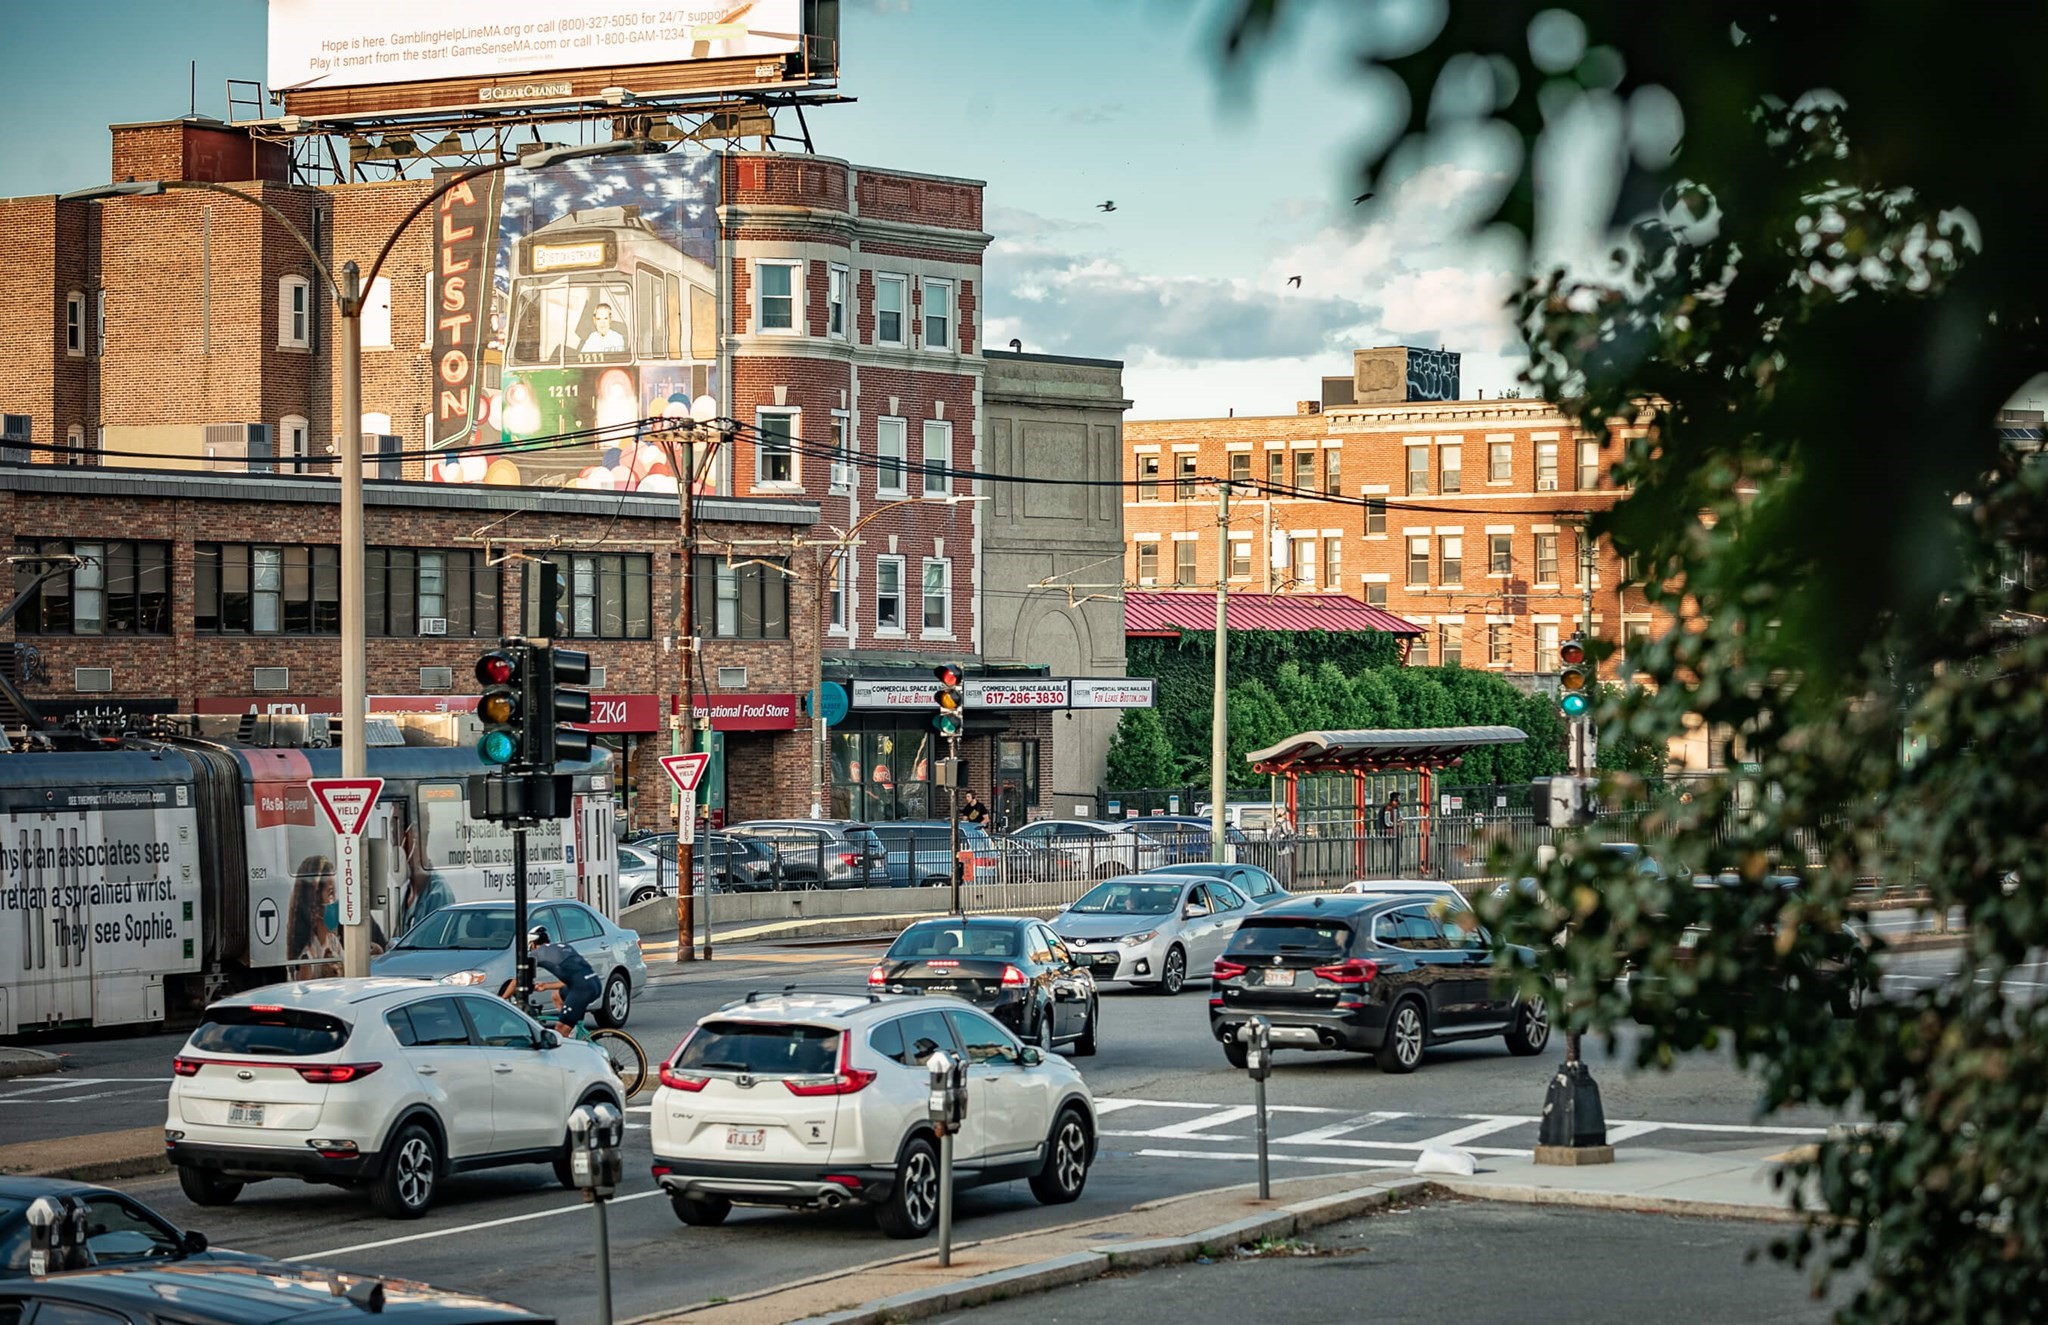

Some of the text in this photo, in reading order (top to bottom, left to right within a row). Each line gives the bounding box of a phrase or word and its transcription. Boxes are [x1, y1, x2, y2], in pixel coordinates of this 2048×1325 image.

[322, 40, 349, 53] Hope
[352, 38, 360, 49] is
[363, 36, 387, 48] here.
[391, 24, 520, 44] GamblingHelpLineMA.org
[523, 24, 534, 34] or
[537, 21, 555, 33] call
[558, 14, 639, 34] (800)-327-5050
[642, 12, 655, 24] for
[660, 11, 685, 24] 24/7
[310, 58, 331, 70] Play
[333, 56, 341, 67] it
[343, 53, 373, 66] smart
[375, 51, 400, 63] from
[403, 49, 419, 61] the
[422, 46, 448, 59] start!
[451, 39, 556, 57] GameSenseMA.com
[560, 36, 571, 48] or
[573, 34, 592, 47] call
[596, 28, 687, 45] 1-800-GAM-1234.
[439, 174, 476, 420] ALLSTON
[578, 353, 605, 363] 1211
[549, 384, 578, 397] 1211
[986, 692, 1064, 704] 617-286-3830
[692, 704, 789, 718] ternational Food Store
[284, 797, 308, 814] Beyond
[337, 806, 359, 815] YIELD
[455, 820, 497, 843] Physician
[546, 822, 561, 836] see
[59, 837, 141, 868] associates
[145, 841, 170, 864] see
[448, 851, 471, 865] more
[473, 845, 493, 864] than
[495, 848, 501, 862] a
[251, 867, 267, 879] 3621
[345, 837, 353, 921] TO TROLLEY
[483, 869, 504, 892] They
[528, 867, 554, 890] ophie.
[15, 881, 47, 910] than
[52, 889, 60, 907] a
[65, 875, 131, 913] sprained
[136, 873, 176, 901] wrist.
[52, 912, 177, 951] They see Sophie.
[259, 909, 275, 937] T
[672, 1112, 694, 1120] CR-V
